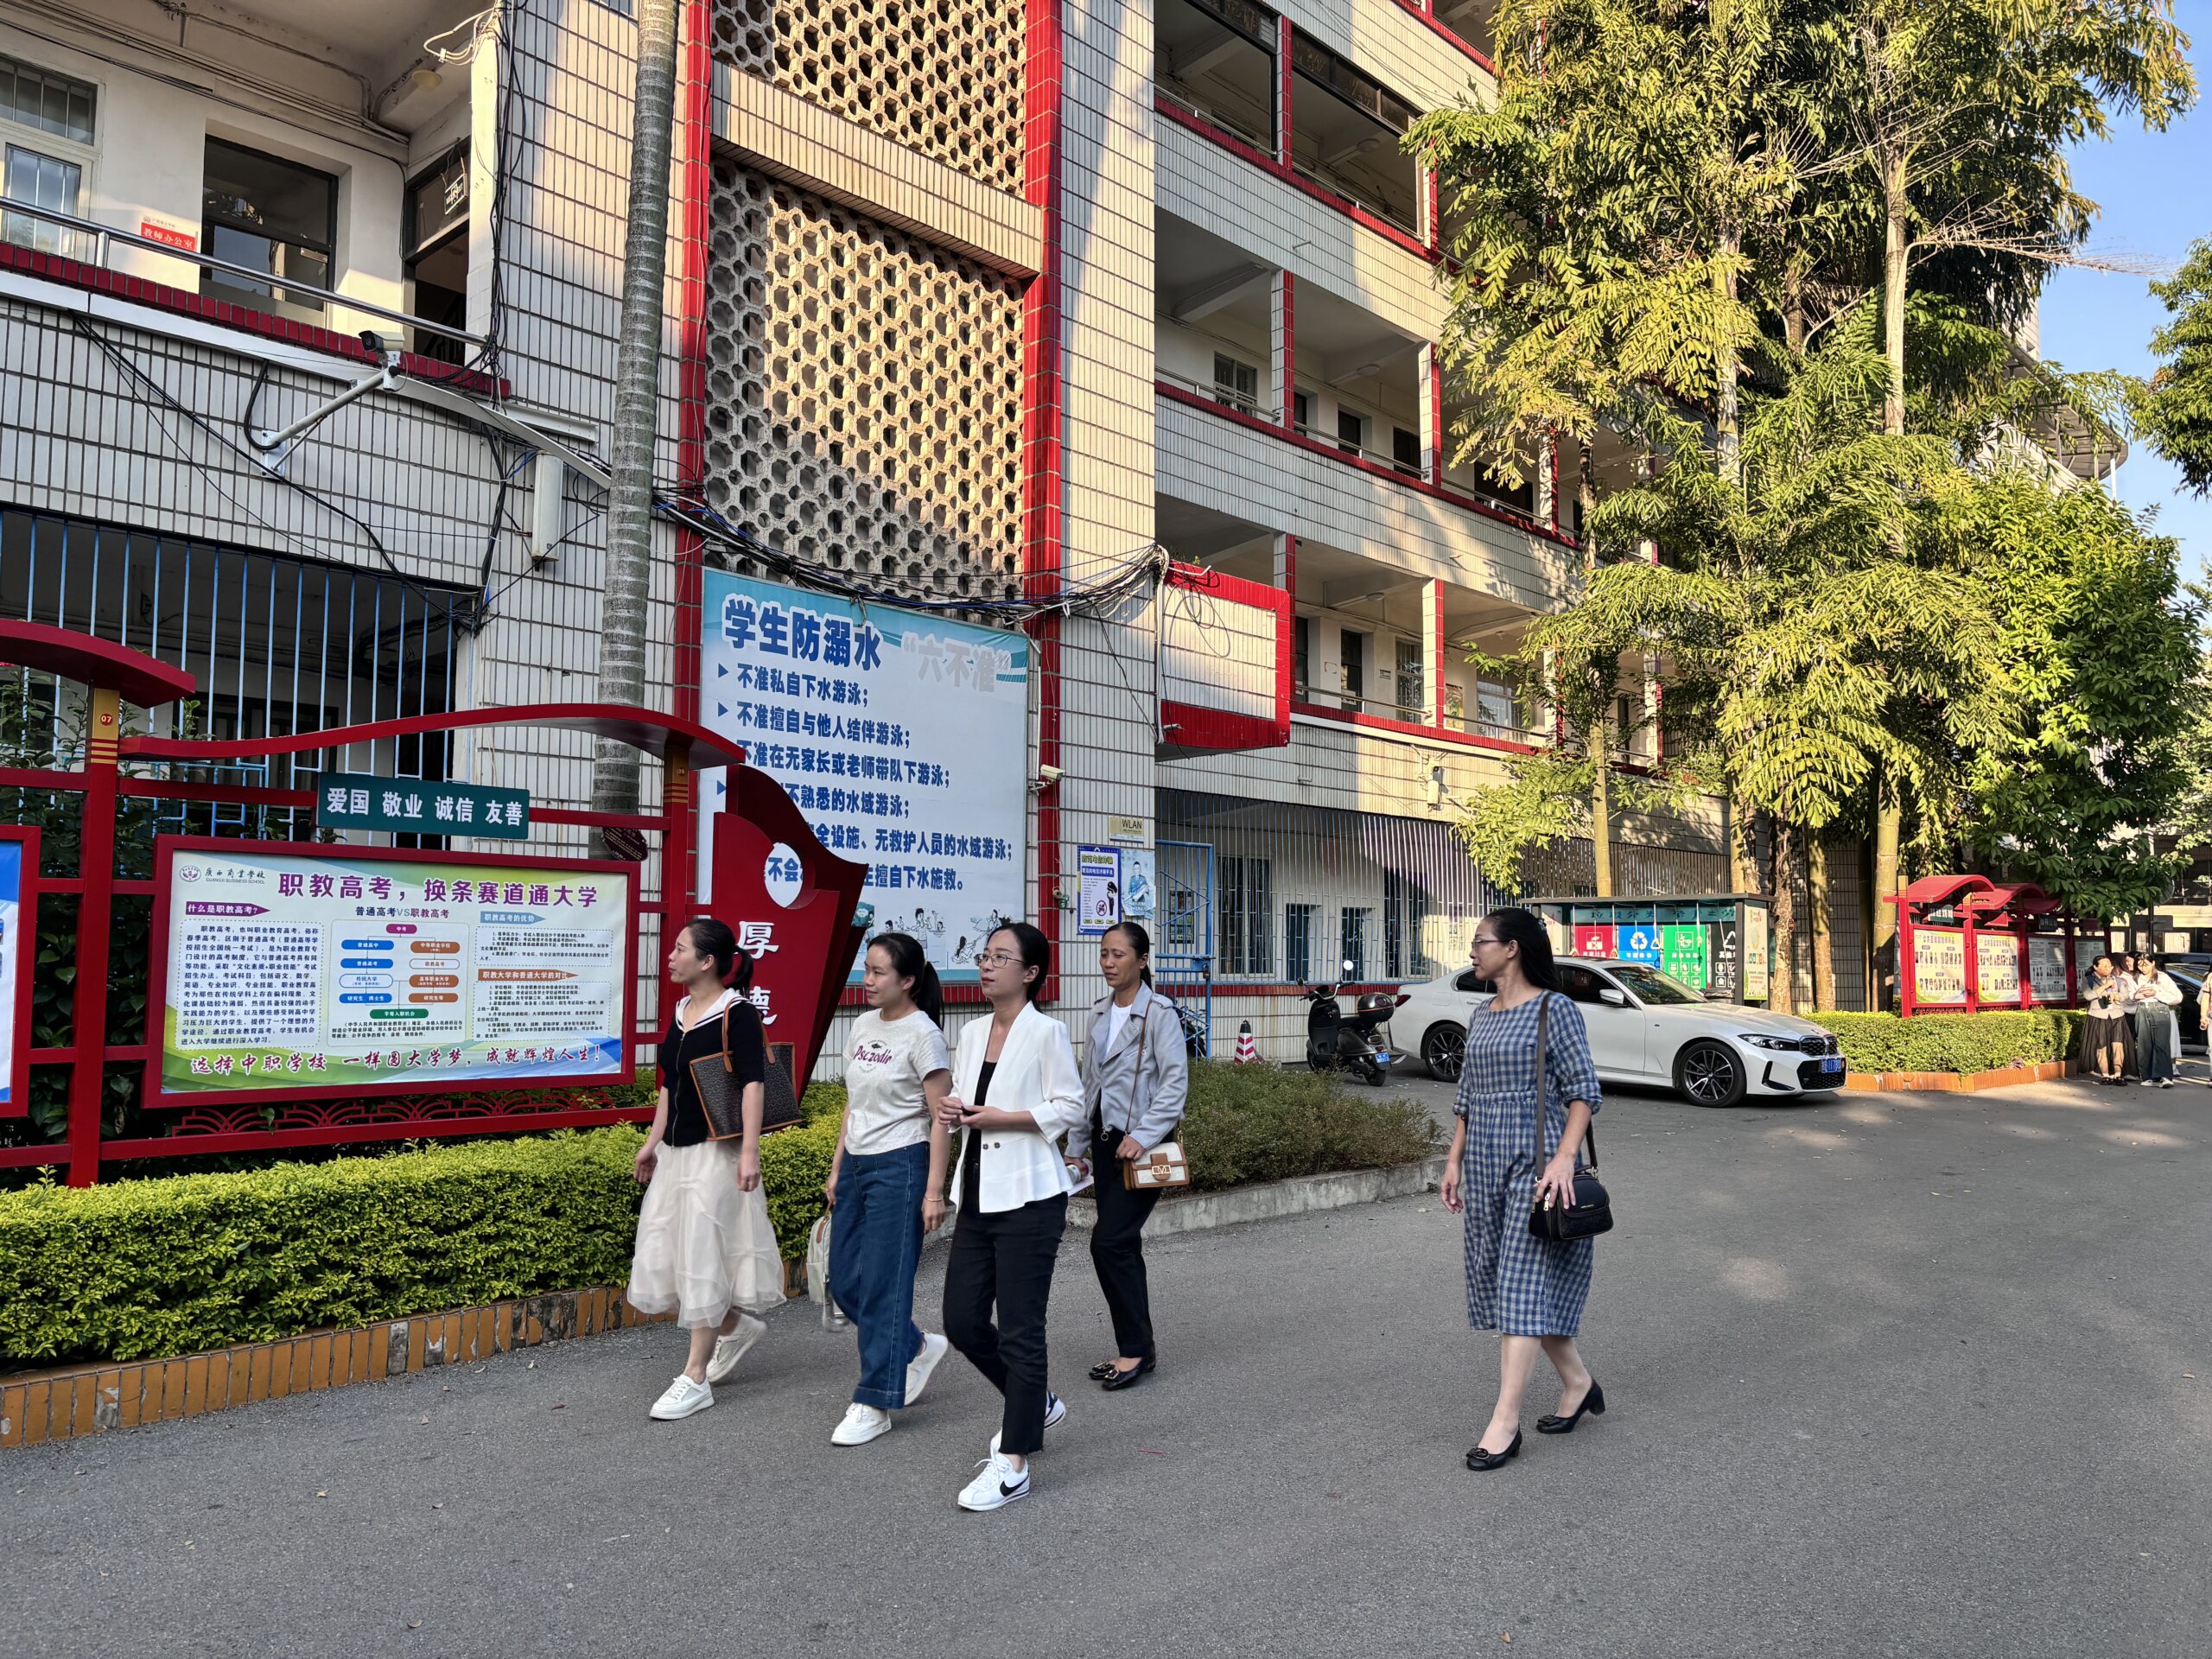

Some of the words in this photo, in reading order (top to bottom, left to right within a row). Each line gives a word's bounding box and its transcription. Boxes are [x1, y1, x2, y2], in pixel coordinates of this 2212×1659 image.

[143, 227, 193, 249] 教师办公室
[724, 598, 881, 671] 学生防溺水
[737, 663, 868, 708] 不准私自下水游泳；
[737, 701, 909, 749] 不准擅自与他人结伴游泳；
[737, 740, 950, 789] 不准在无家长或老师带队下游泳；
[327, 786, 370, 816] 爱国
[382, 790, 423, 819] 敬业
[434, 796, 474, 823] 诚信
[485, 798, 523, 827] 友善
[781, 783, 909, 819] 不熟悉的水域游泳；
[1122, 820, 1142, 830] WLAN
[278, 873, 597, 907] 职教高考，换条赛道通大学
[355, 906, 449, 918] 普通高考VS职教高考
[484, 912, 535, 923] 职教高考的优势
[482, 970, 568, 979] 职教大学和普通大学的对比
[190, 1052, 327, 1075] 选择中职学校
